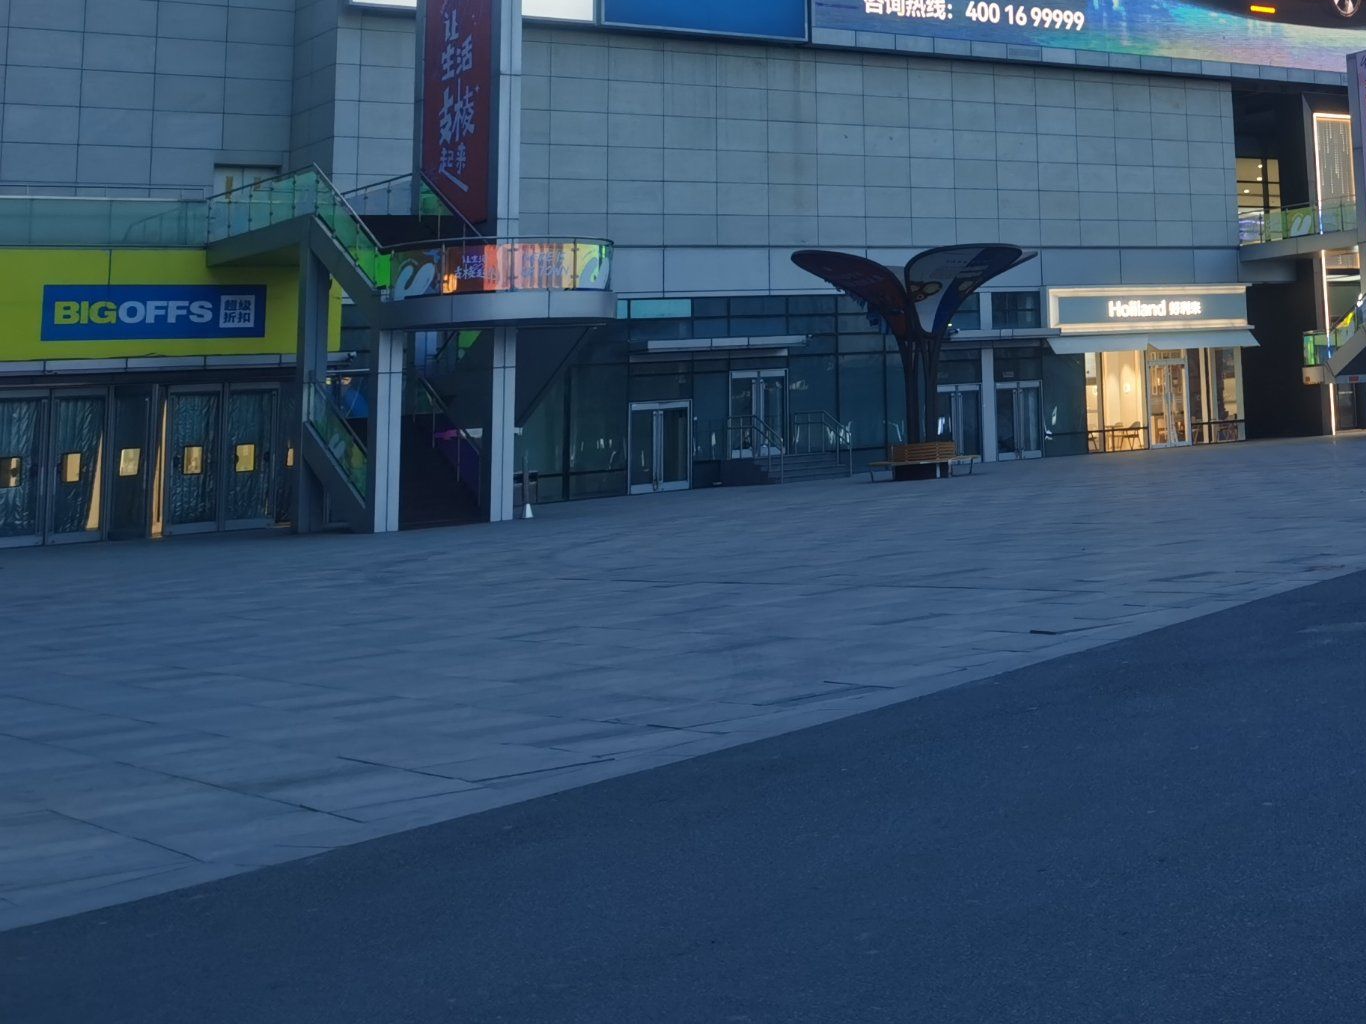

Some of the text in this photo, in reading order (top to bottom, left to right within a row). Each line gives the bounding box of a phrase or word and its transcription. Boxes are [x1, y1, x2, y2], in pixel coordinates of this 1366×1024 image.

[965, 1, 1000, 24] 400
[1004, 5, 1027, 26] 16
[1030, 7, 1085, 31] 99999
[54, 300, 213, 324] BIGOFFS
[223, 311, 251, 324] 折扣
